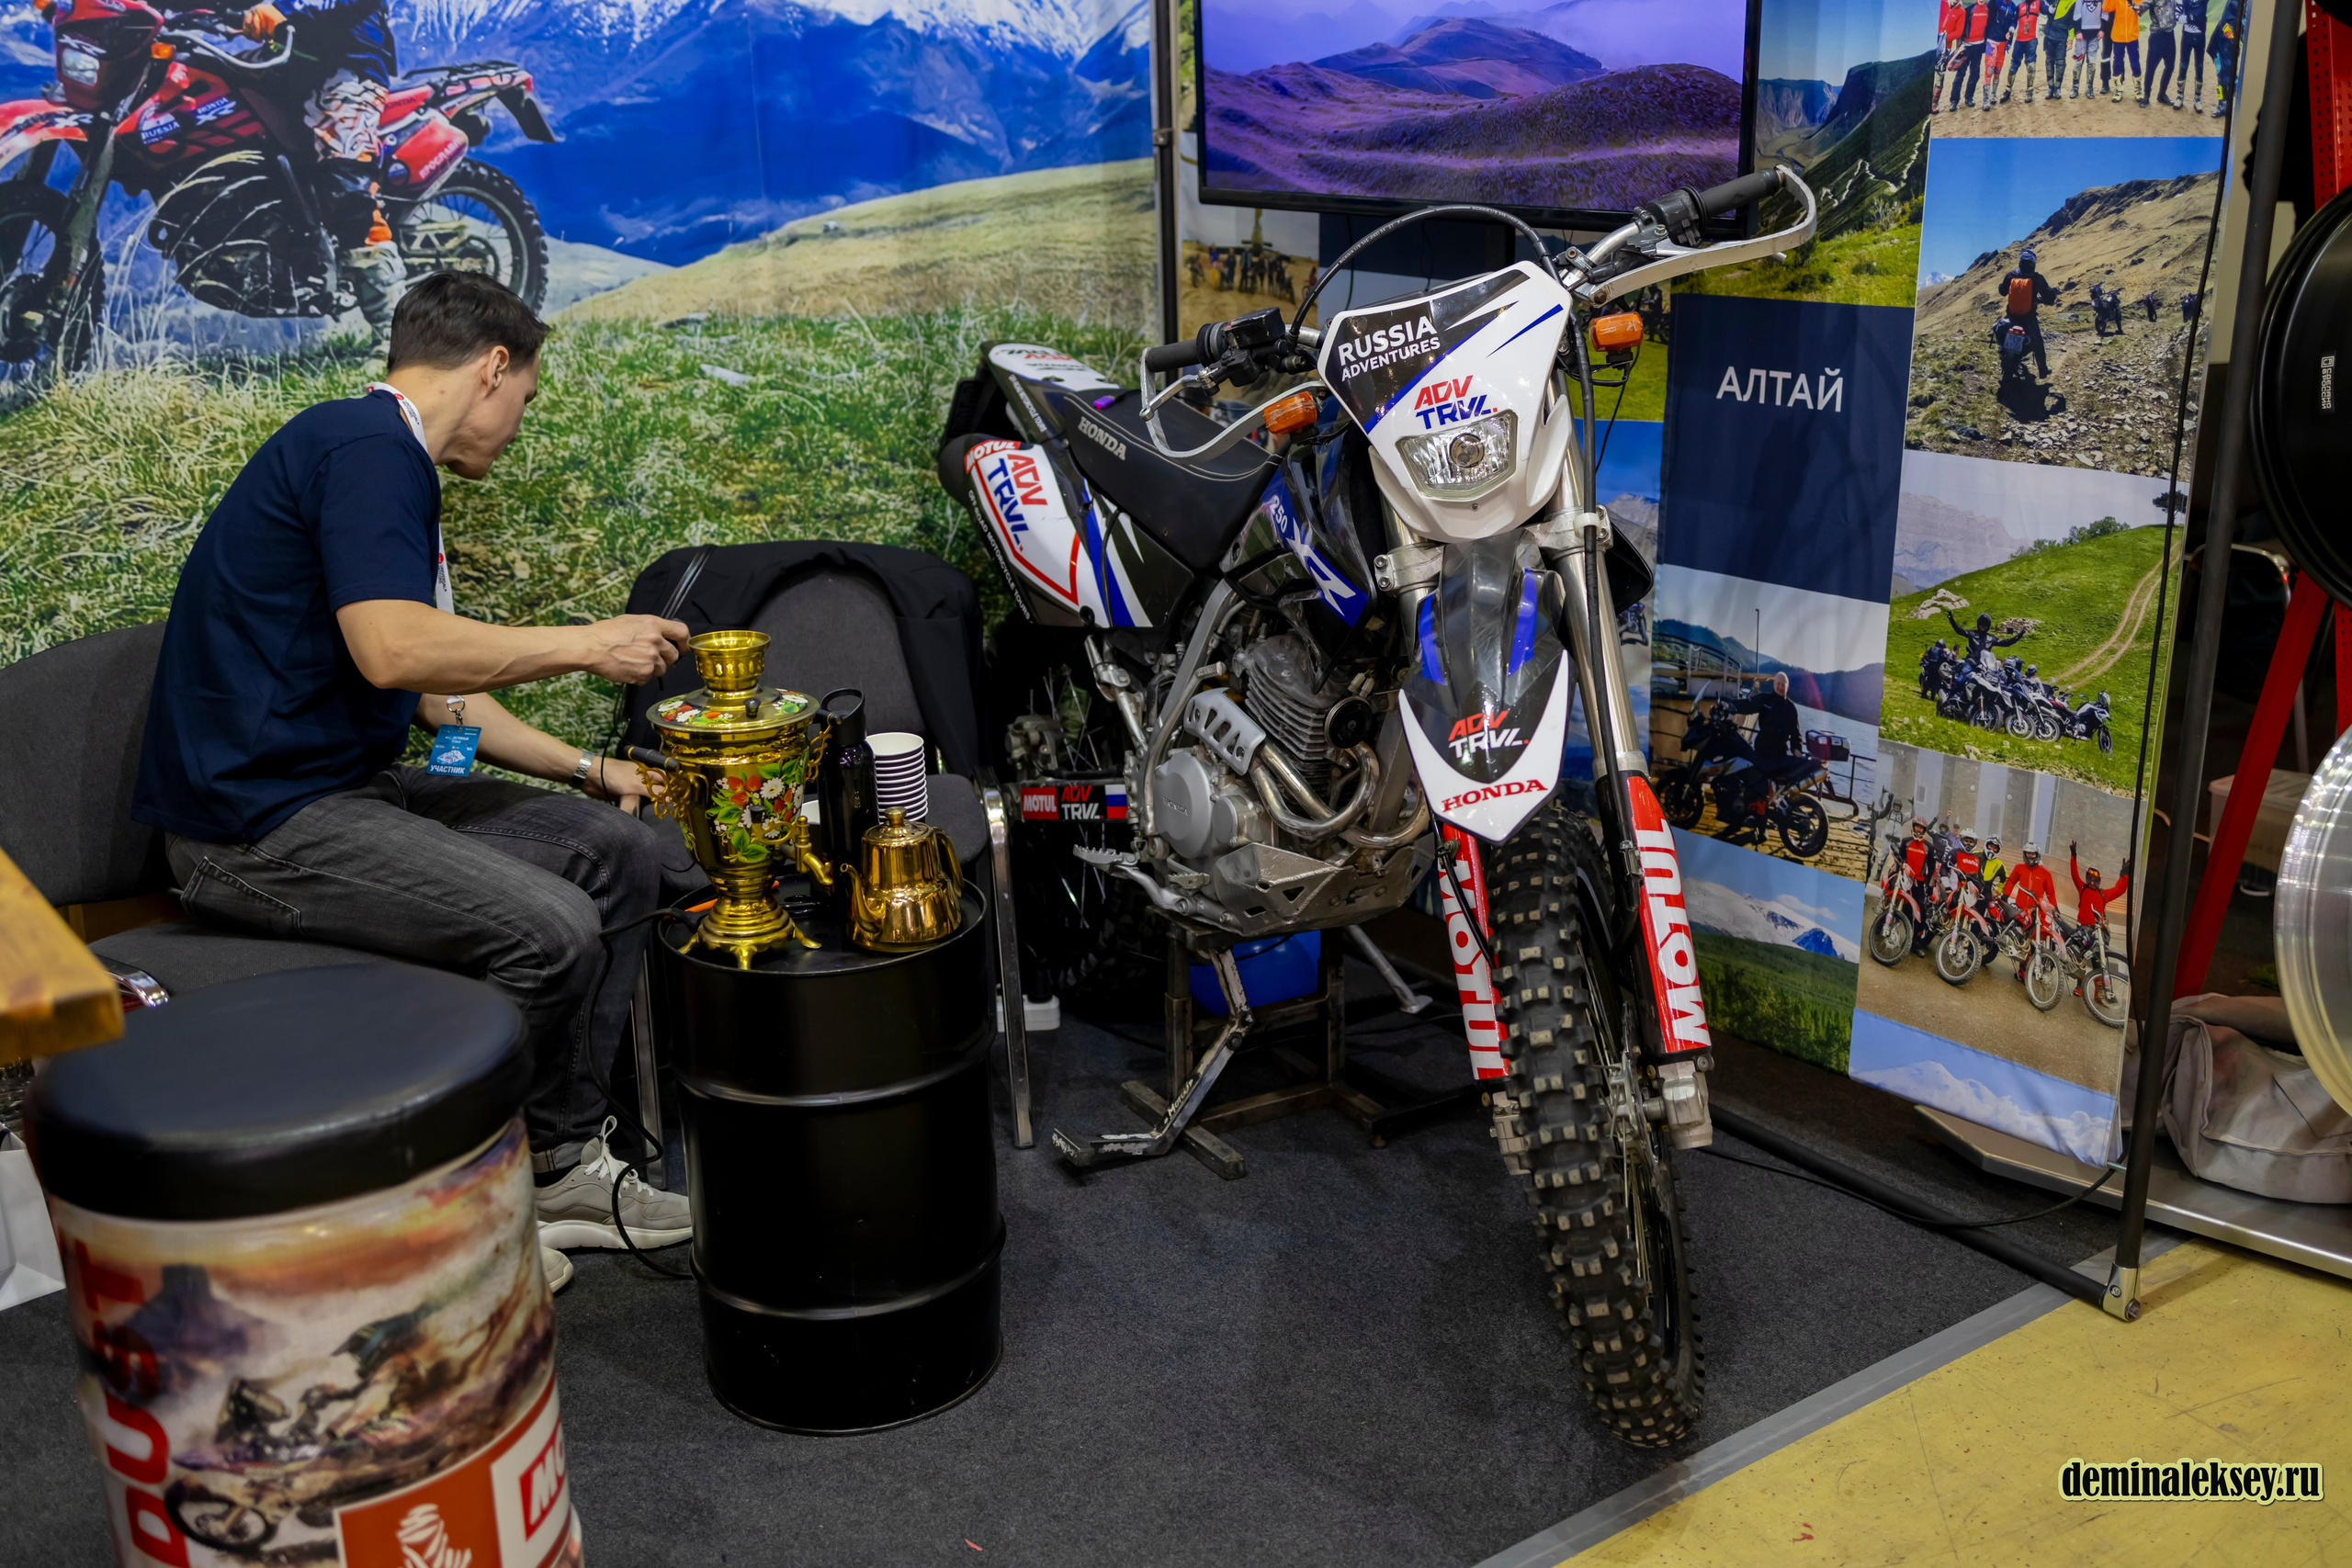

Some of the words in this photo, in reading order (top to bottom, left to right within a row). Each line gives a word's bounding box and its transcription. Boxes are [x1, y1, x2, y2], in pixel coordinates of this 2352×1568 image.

[197, 96, 229, 115] HONDA
[141, 120, 180, 141] RUSSIA
[1338, 316, 1437, 367] RUSSIA
[1341, 337, 1441, 382] ADVENTURES
[1414, 375, 1474, 411] ADV
[1716, 367, 1843, 412] АЛТАЙ
[967, 440, 1016, 467] MOTUL
[1078, 416, 1126, 460] HONDA
[1007, 454, 1048, 505] ADV
[1270, 494, 1288, 534] 250
[968, 490, 989, 534] OFF-ROAD
[987, 532, 1015, 591] MOTORCYCLE
[1013, 589, 1031, 620] TOURS
[1448, 710, 1509, 742] ADV
[429, 763, 466, 774] УЧАСТНИК
[1023, 795, 1057, 812] MOTUL
[1061, 785, 1092, 802] ADV
[1162, 797, 1189, 817] HONDA
[1442, 779, 1548, 812] HONDA
[1635, 818, 1712, 1046] MOTUL
[1438, 860, 1504, 1080] MOTUL
